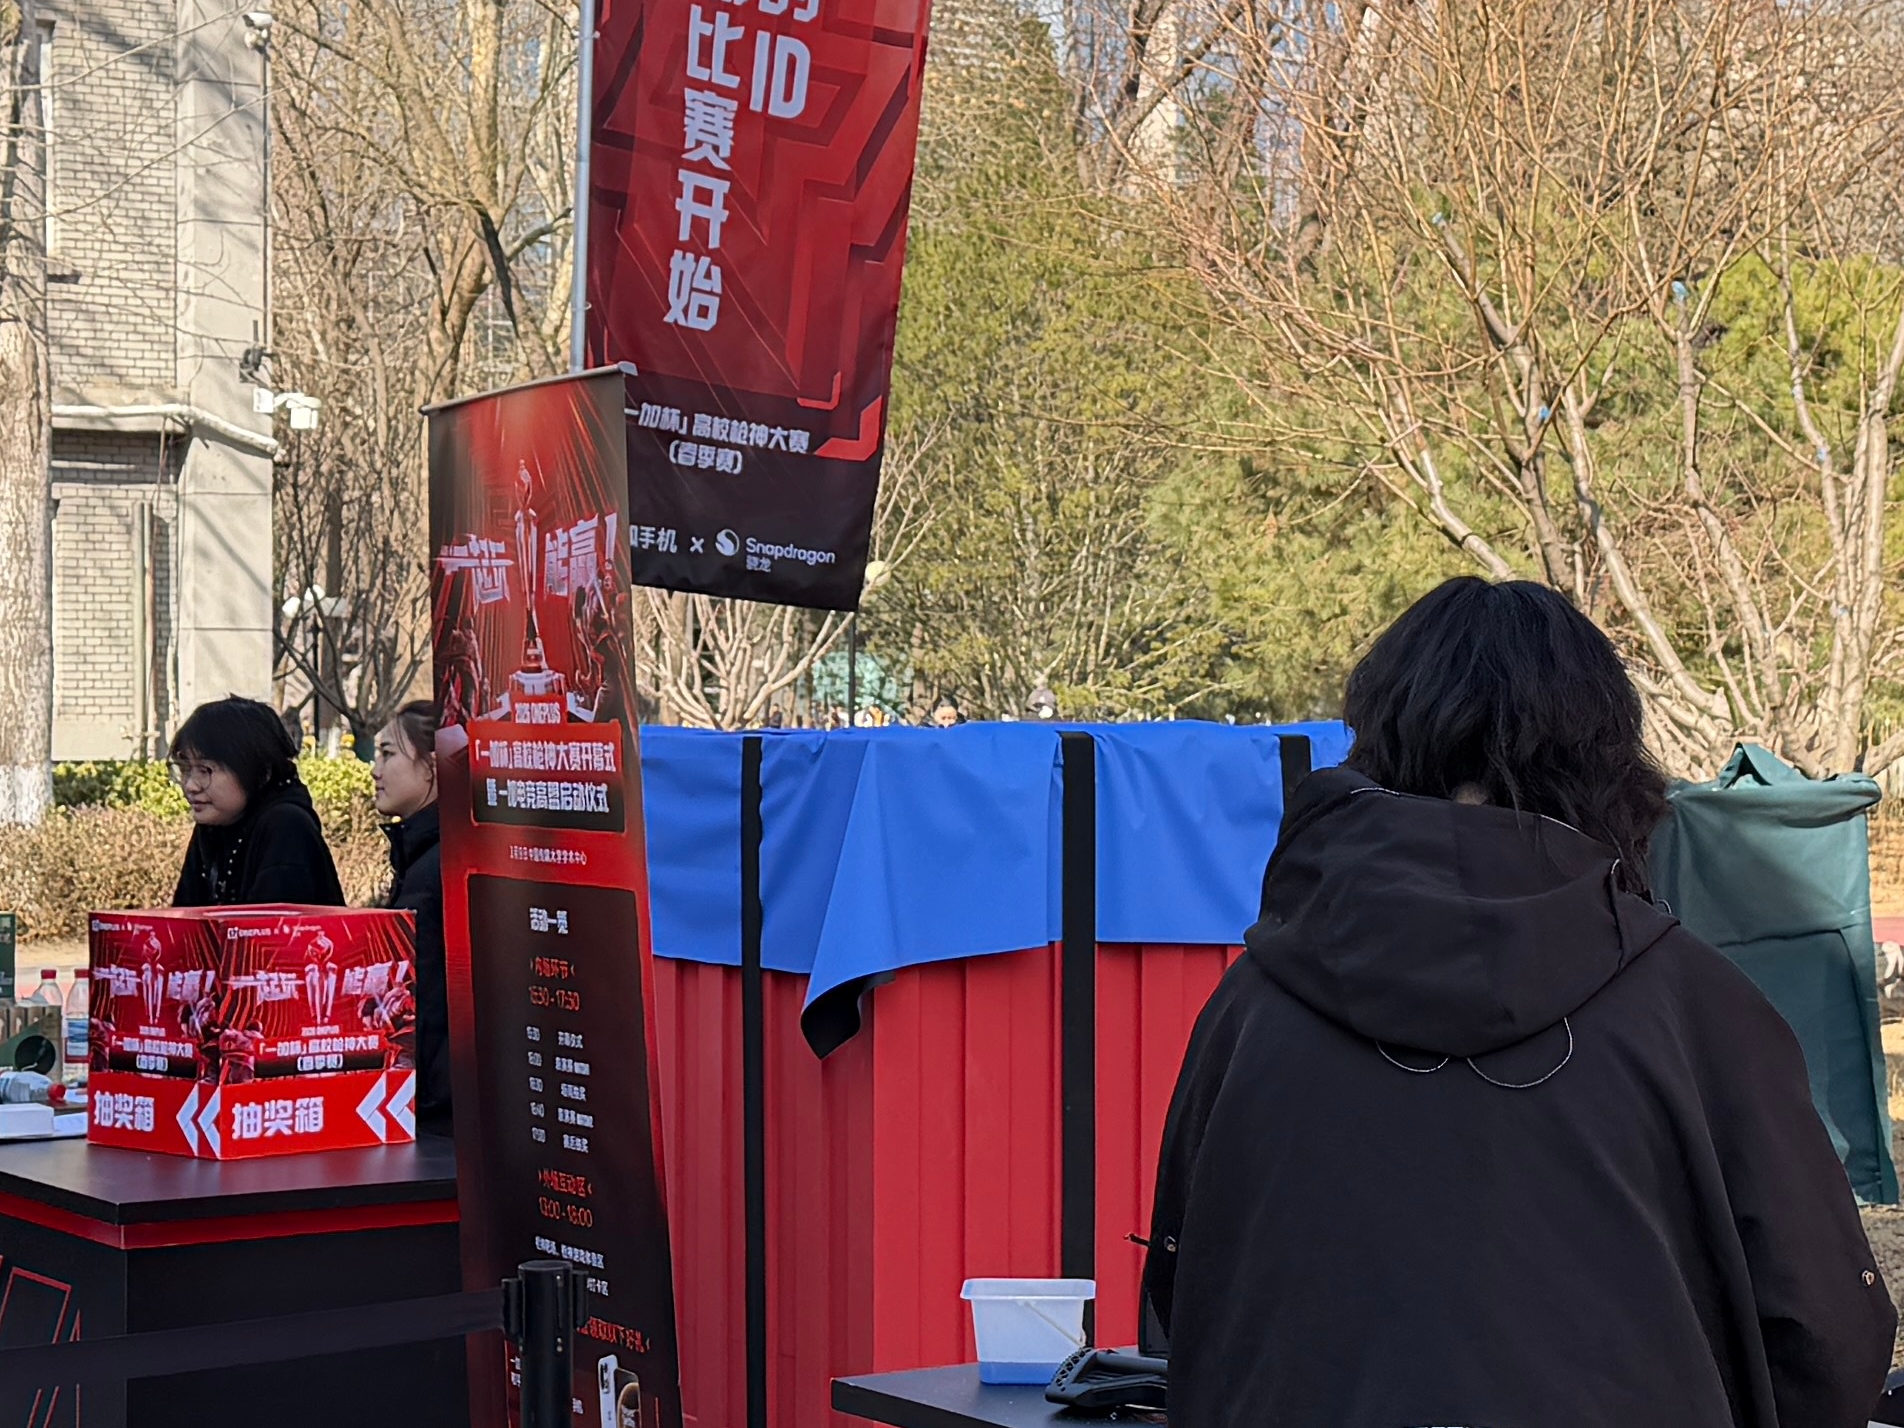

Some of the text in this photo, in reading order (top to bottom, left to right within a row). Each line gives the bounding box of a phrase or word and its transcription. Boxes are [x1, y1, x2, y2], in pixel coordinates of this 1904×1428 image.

[746, 537, 836, 565] Snapdragon
[93, 1090, 155, 1132] 抽奖箱
[231, 1095, 325, 1140] 抽奖箱
